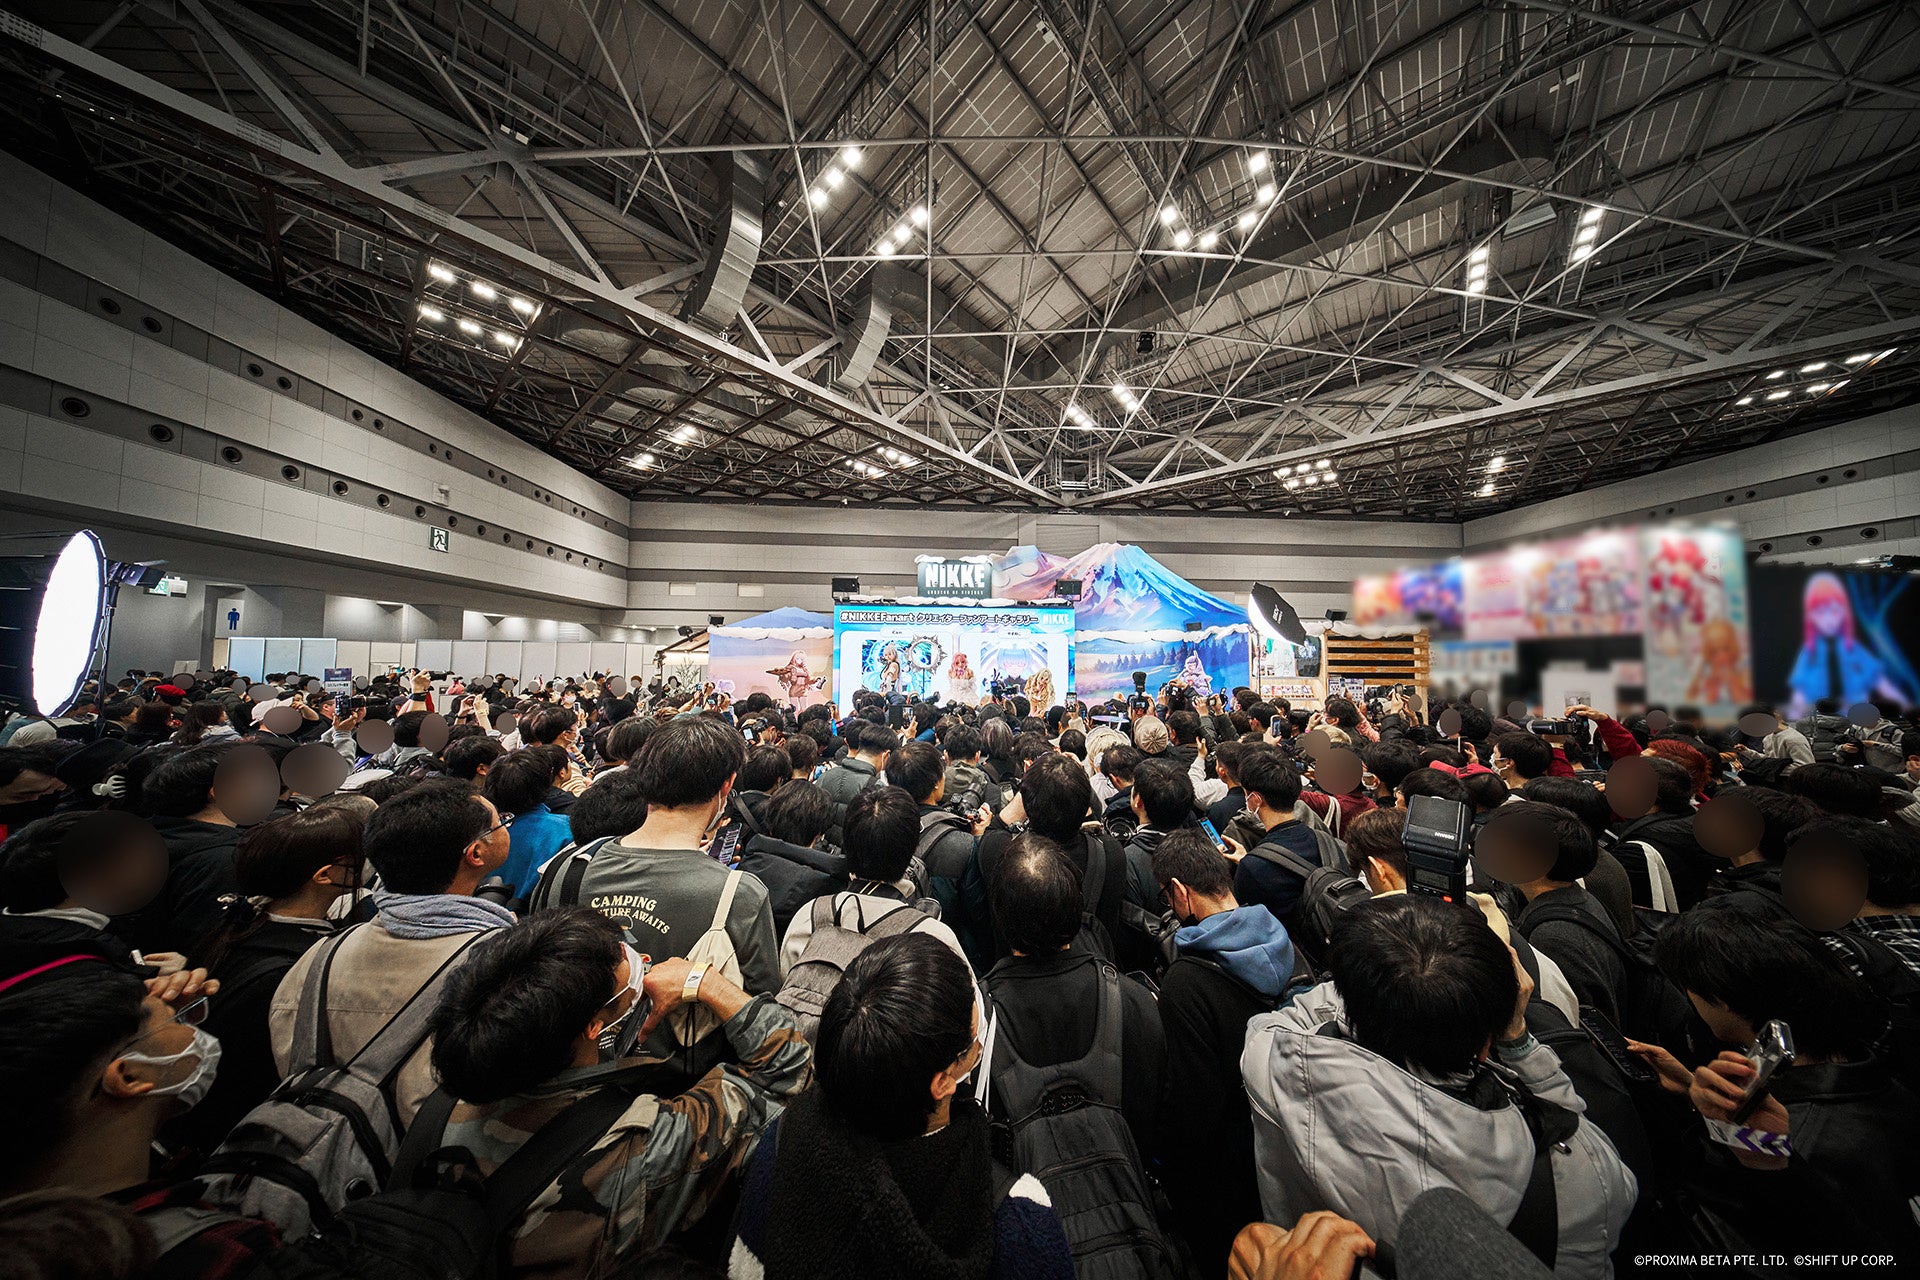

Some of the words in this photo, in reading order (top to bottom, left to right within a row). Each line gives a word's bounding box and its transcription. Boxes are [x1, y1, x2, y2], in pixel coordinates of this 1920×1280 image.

[926, 564, 985, 588] NIKKE
[840, 611, 915, 623] #NIKKEFanart
[1043, 614, 1069, 625] NIKKE
[591, 895, 657, 912] CAMPING
[598, 907, 631, 917] TURE
[631, 909, 670, 934] AWAITS
